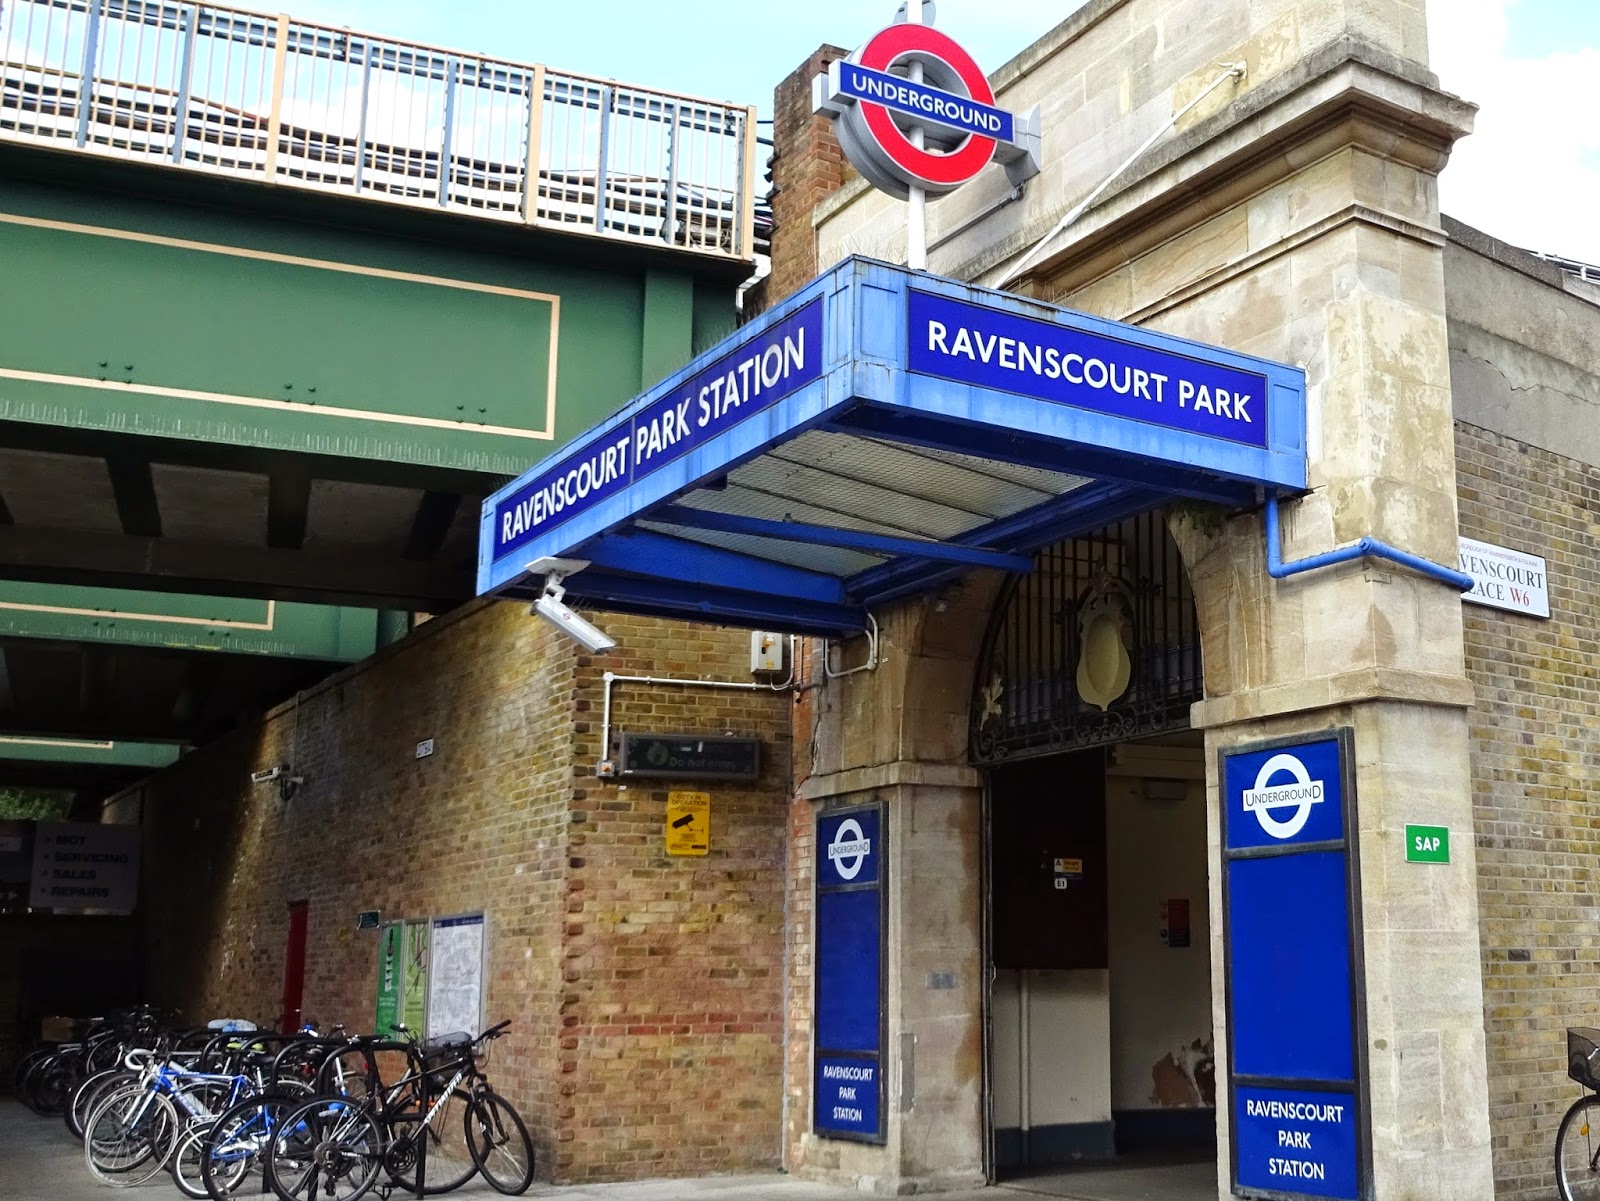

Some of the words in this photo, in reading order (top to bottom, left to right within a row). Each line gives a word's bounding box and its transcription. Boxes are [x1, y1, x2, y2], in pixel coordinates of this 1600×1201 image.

[851, 73, 1002, 132] UNDERGROUND
[928, 319, 1168, 402] RAVENSCOURT
[1178, 379, 1252, 423] PARK
[501, 436, 631, 544] RAVENSCOURT
[635, 397, 692, 466] PARK
[698, 327, 805, 428] STATION
[1509, 587, 1530, 607] W6
[1245, 785, 1322, 807] UNDERGROUND
[829, 841, 869, 857] UNDERGROUND
[1415, 836, 1440, 852] SAP
[52, 869, 97, 880] SALES
[51, 887, 110, 898] REPAIRS
[823, 1065, 873, 1081] RAVENSCOURT
[839, 1086, 857, 1100] PARK
[833, 1106, 862, 1122] STATION
[1246, 1099, 1344, 1123] RAVENSCOURT
[1278, 1130, 1312, 1149] PARK
[1269, 1157, 1325, 1180] STATION
